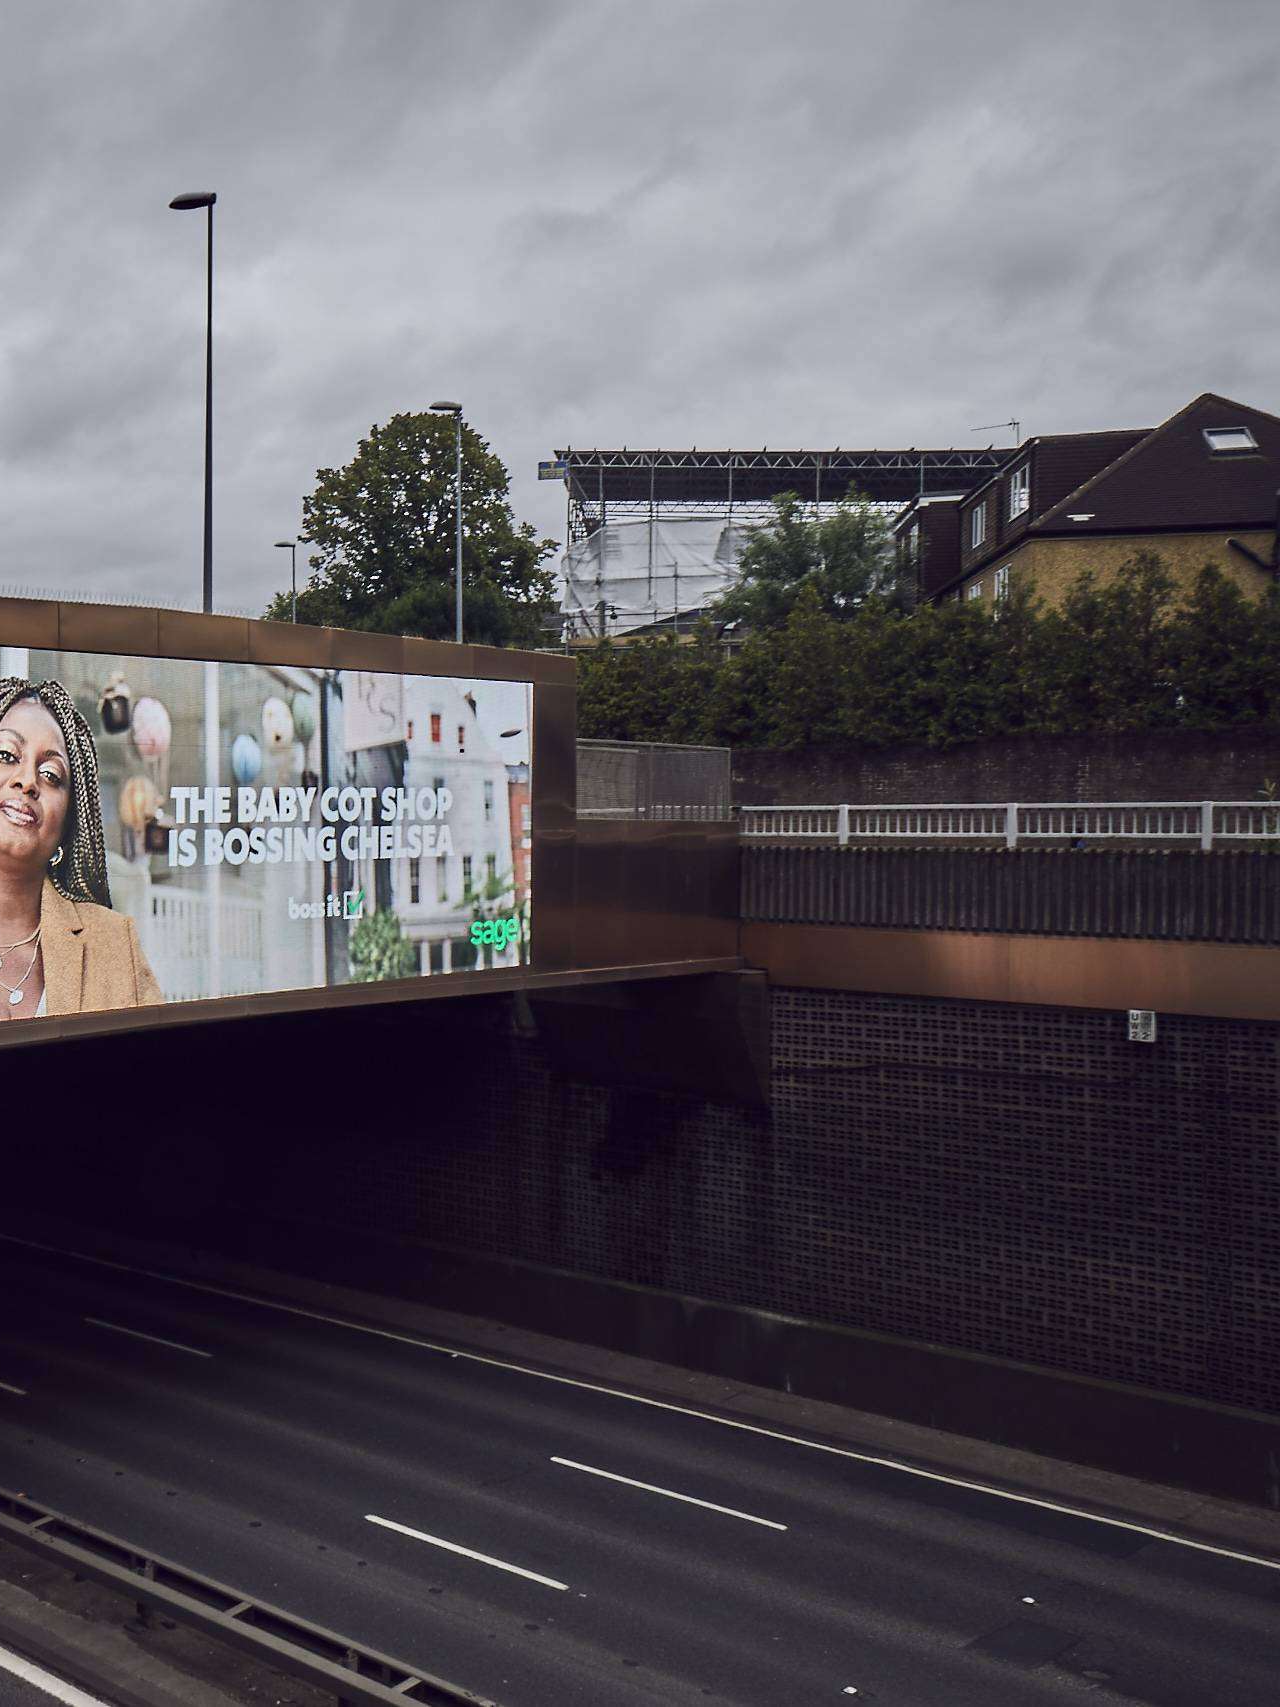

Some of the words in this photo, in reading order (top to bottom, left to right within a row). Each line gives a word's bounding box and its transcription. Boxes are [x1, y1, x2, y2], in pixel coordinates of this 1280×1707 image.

[170, 786, 232, 824] THE
[237, 786, 317, 823] BABY
[320, 786, 377, 823] COT
[380, 786, 453, 822] SHOP
[168, 827, 198, 867] IS
[204, 825, 337, 866] BOSSING
[340, 824, 455, 861] CHELSEA
[326, 894, 341, 917] it
[470, 918, 519, 951] sage
